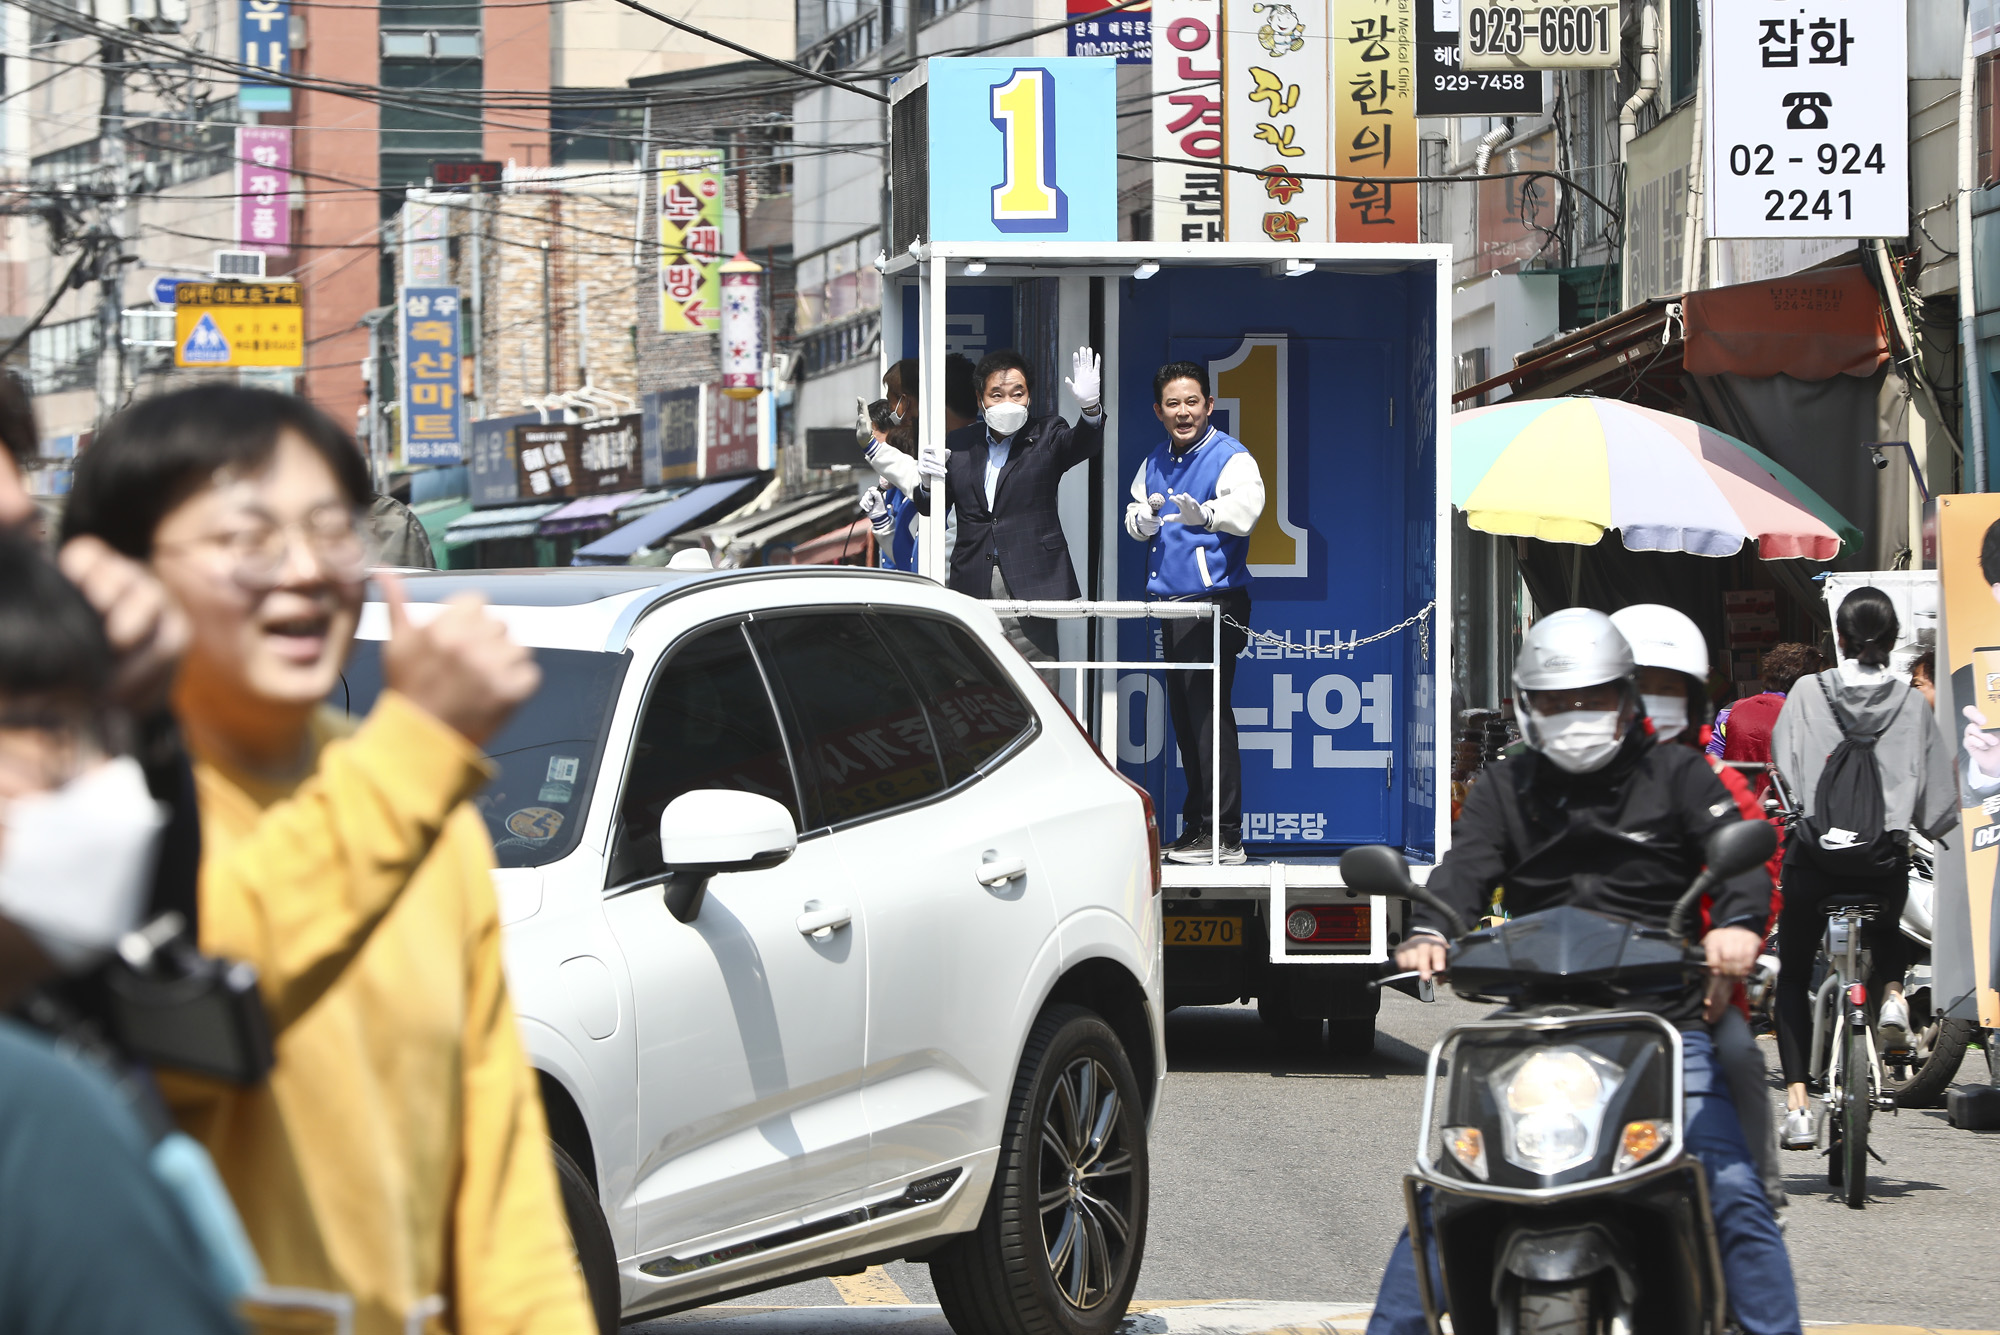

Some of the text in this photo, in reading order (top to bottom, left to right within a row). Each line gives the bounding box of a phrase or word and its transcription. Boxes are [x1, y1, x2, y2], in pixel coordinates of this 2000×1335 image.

[1398, 17, 1410, 64] Medical
[1468, 6, 1610, 54] 923-6601
[1759, 17, 1855, 67] 잡화
[1398, 67, 1410, 98] Clinic
[1434, 74, 1525, 91] 929-7458
[1349, 0, 1396, 225] 광한의원
[990, 67, 1068, 233] 1
[1730, 144, 1774, 176] 02
[1817, 143, 1886, 174] 924
[1764, 189, 1852, 221] 2241
[664, 183, 721, 302] 노래방
[409, 320, 457, 440] 축산마트
[1173, 919, 1234, 942] 2370
